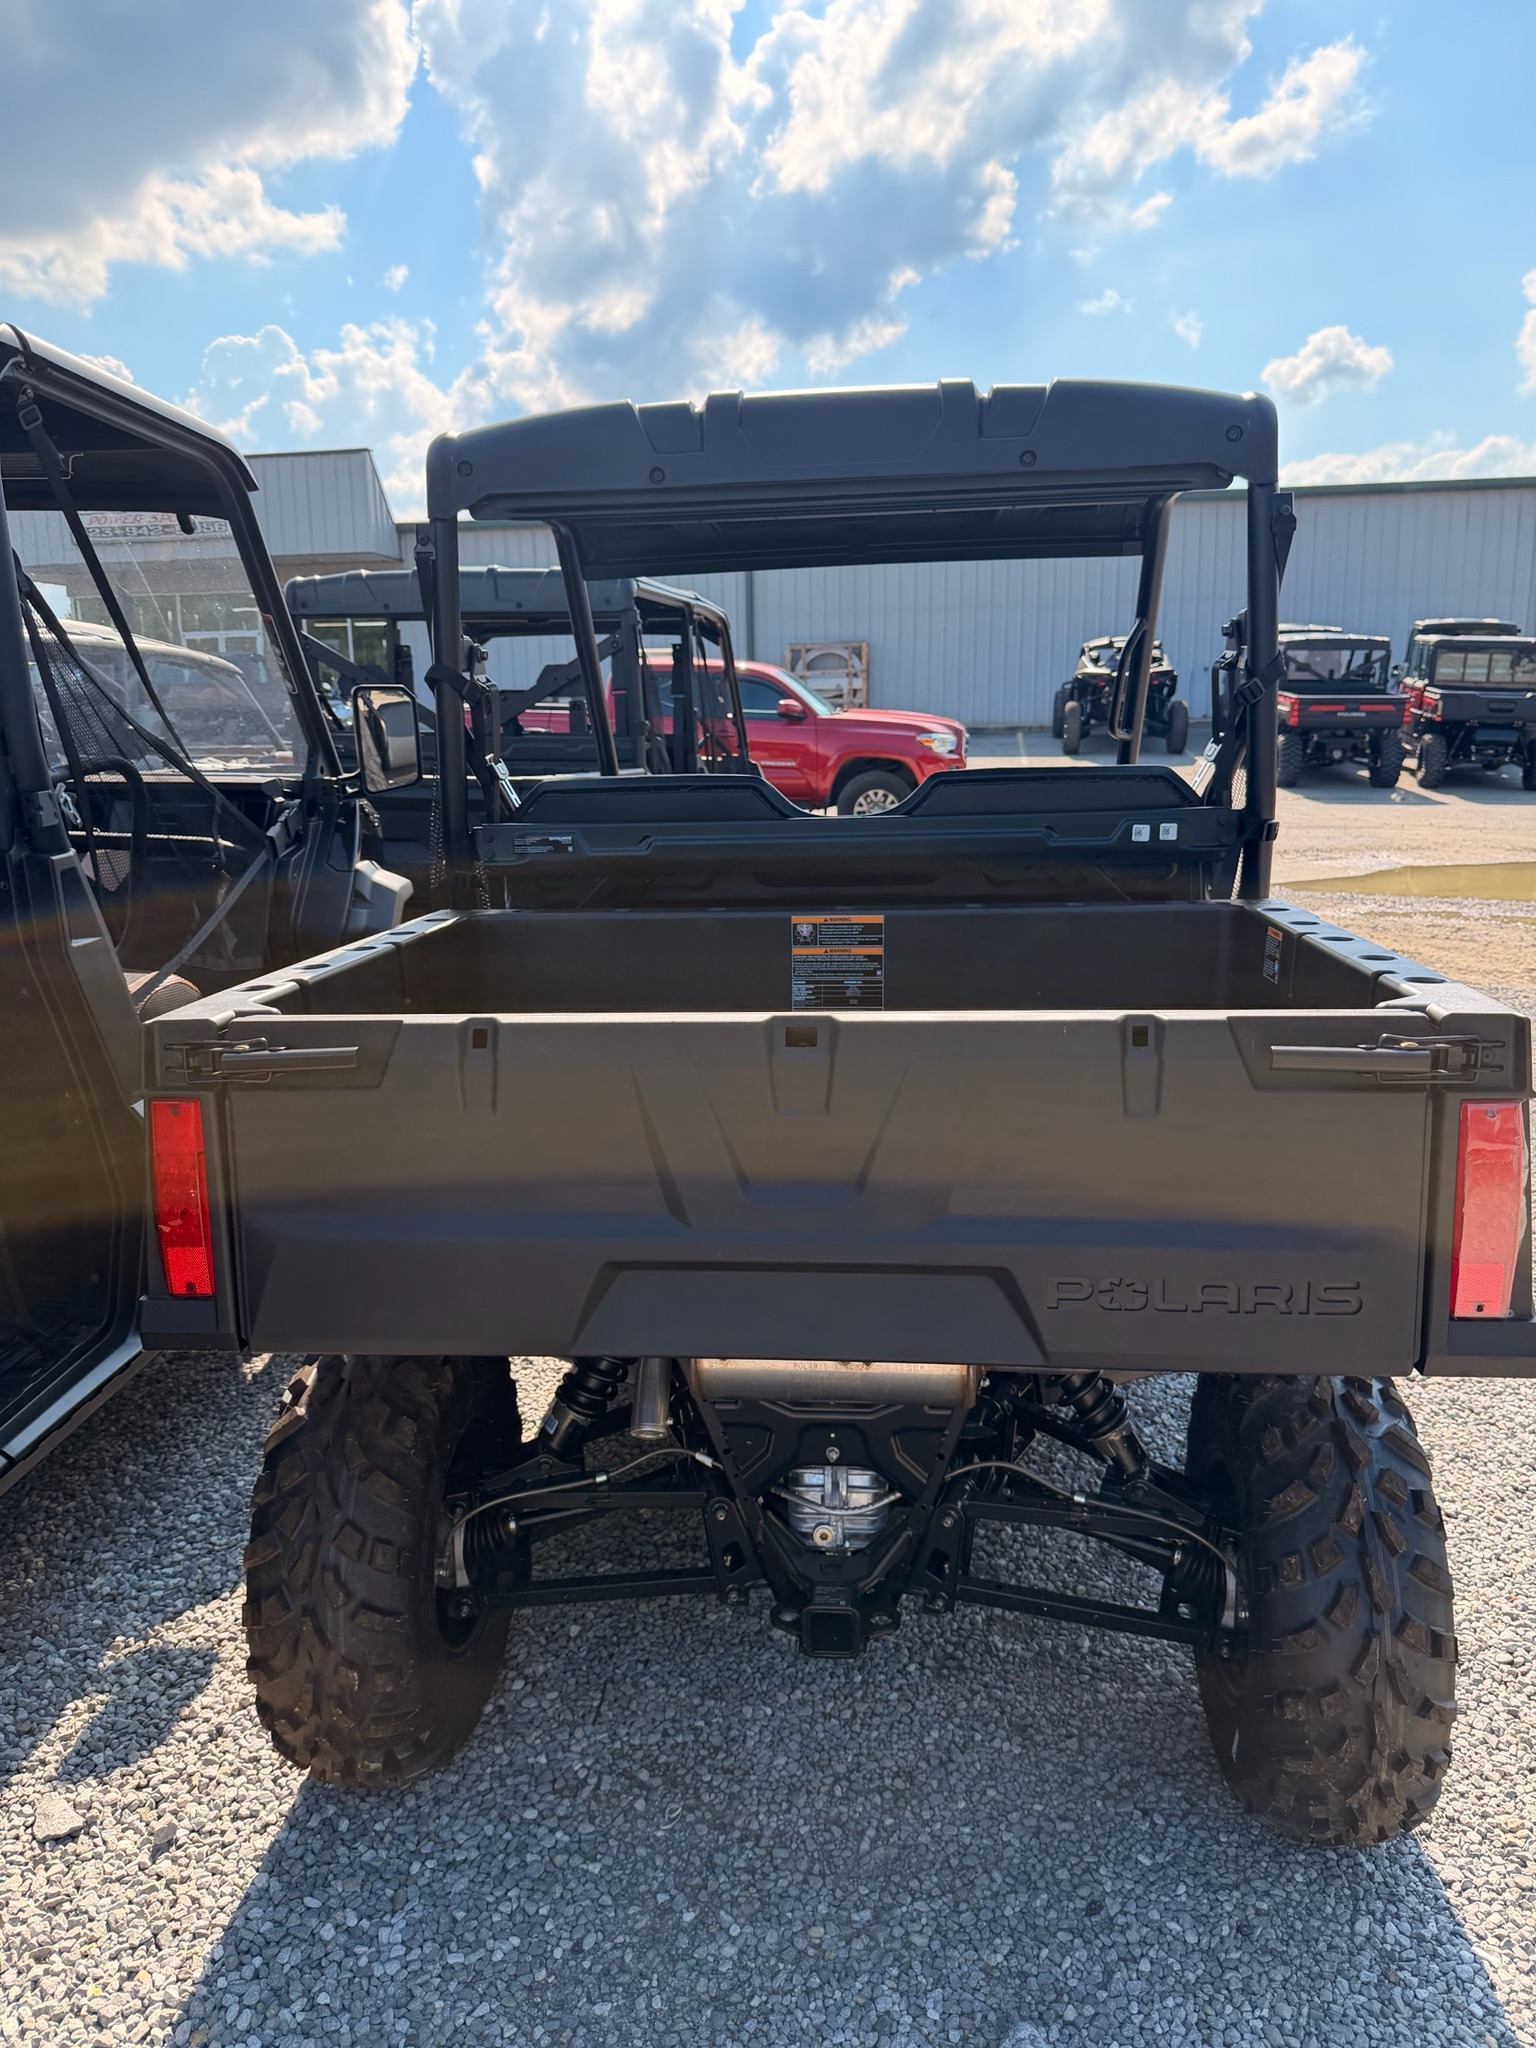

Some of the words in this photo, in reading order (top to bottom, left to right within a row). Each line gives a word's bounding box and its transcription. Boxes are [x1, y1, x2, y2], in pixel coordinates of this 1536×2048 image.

[88, 514, 144, 526] POWER
[1046, 1277, 1364, 1316] POLARIS
[793, 1362, 829, 1370] POLARIS
